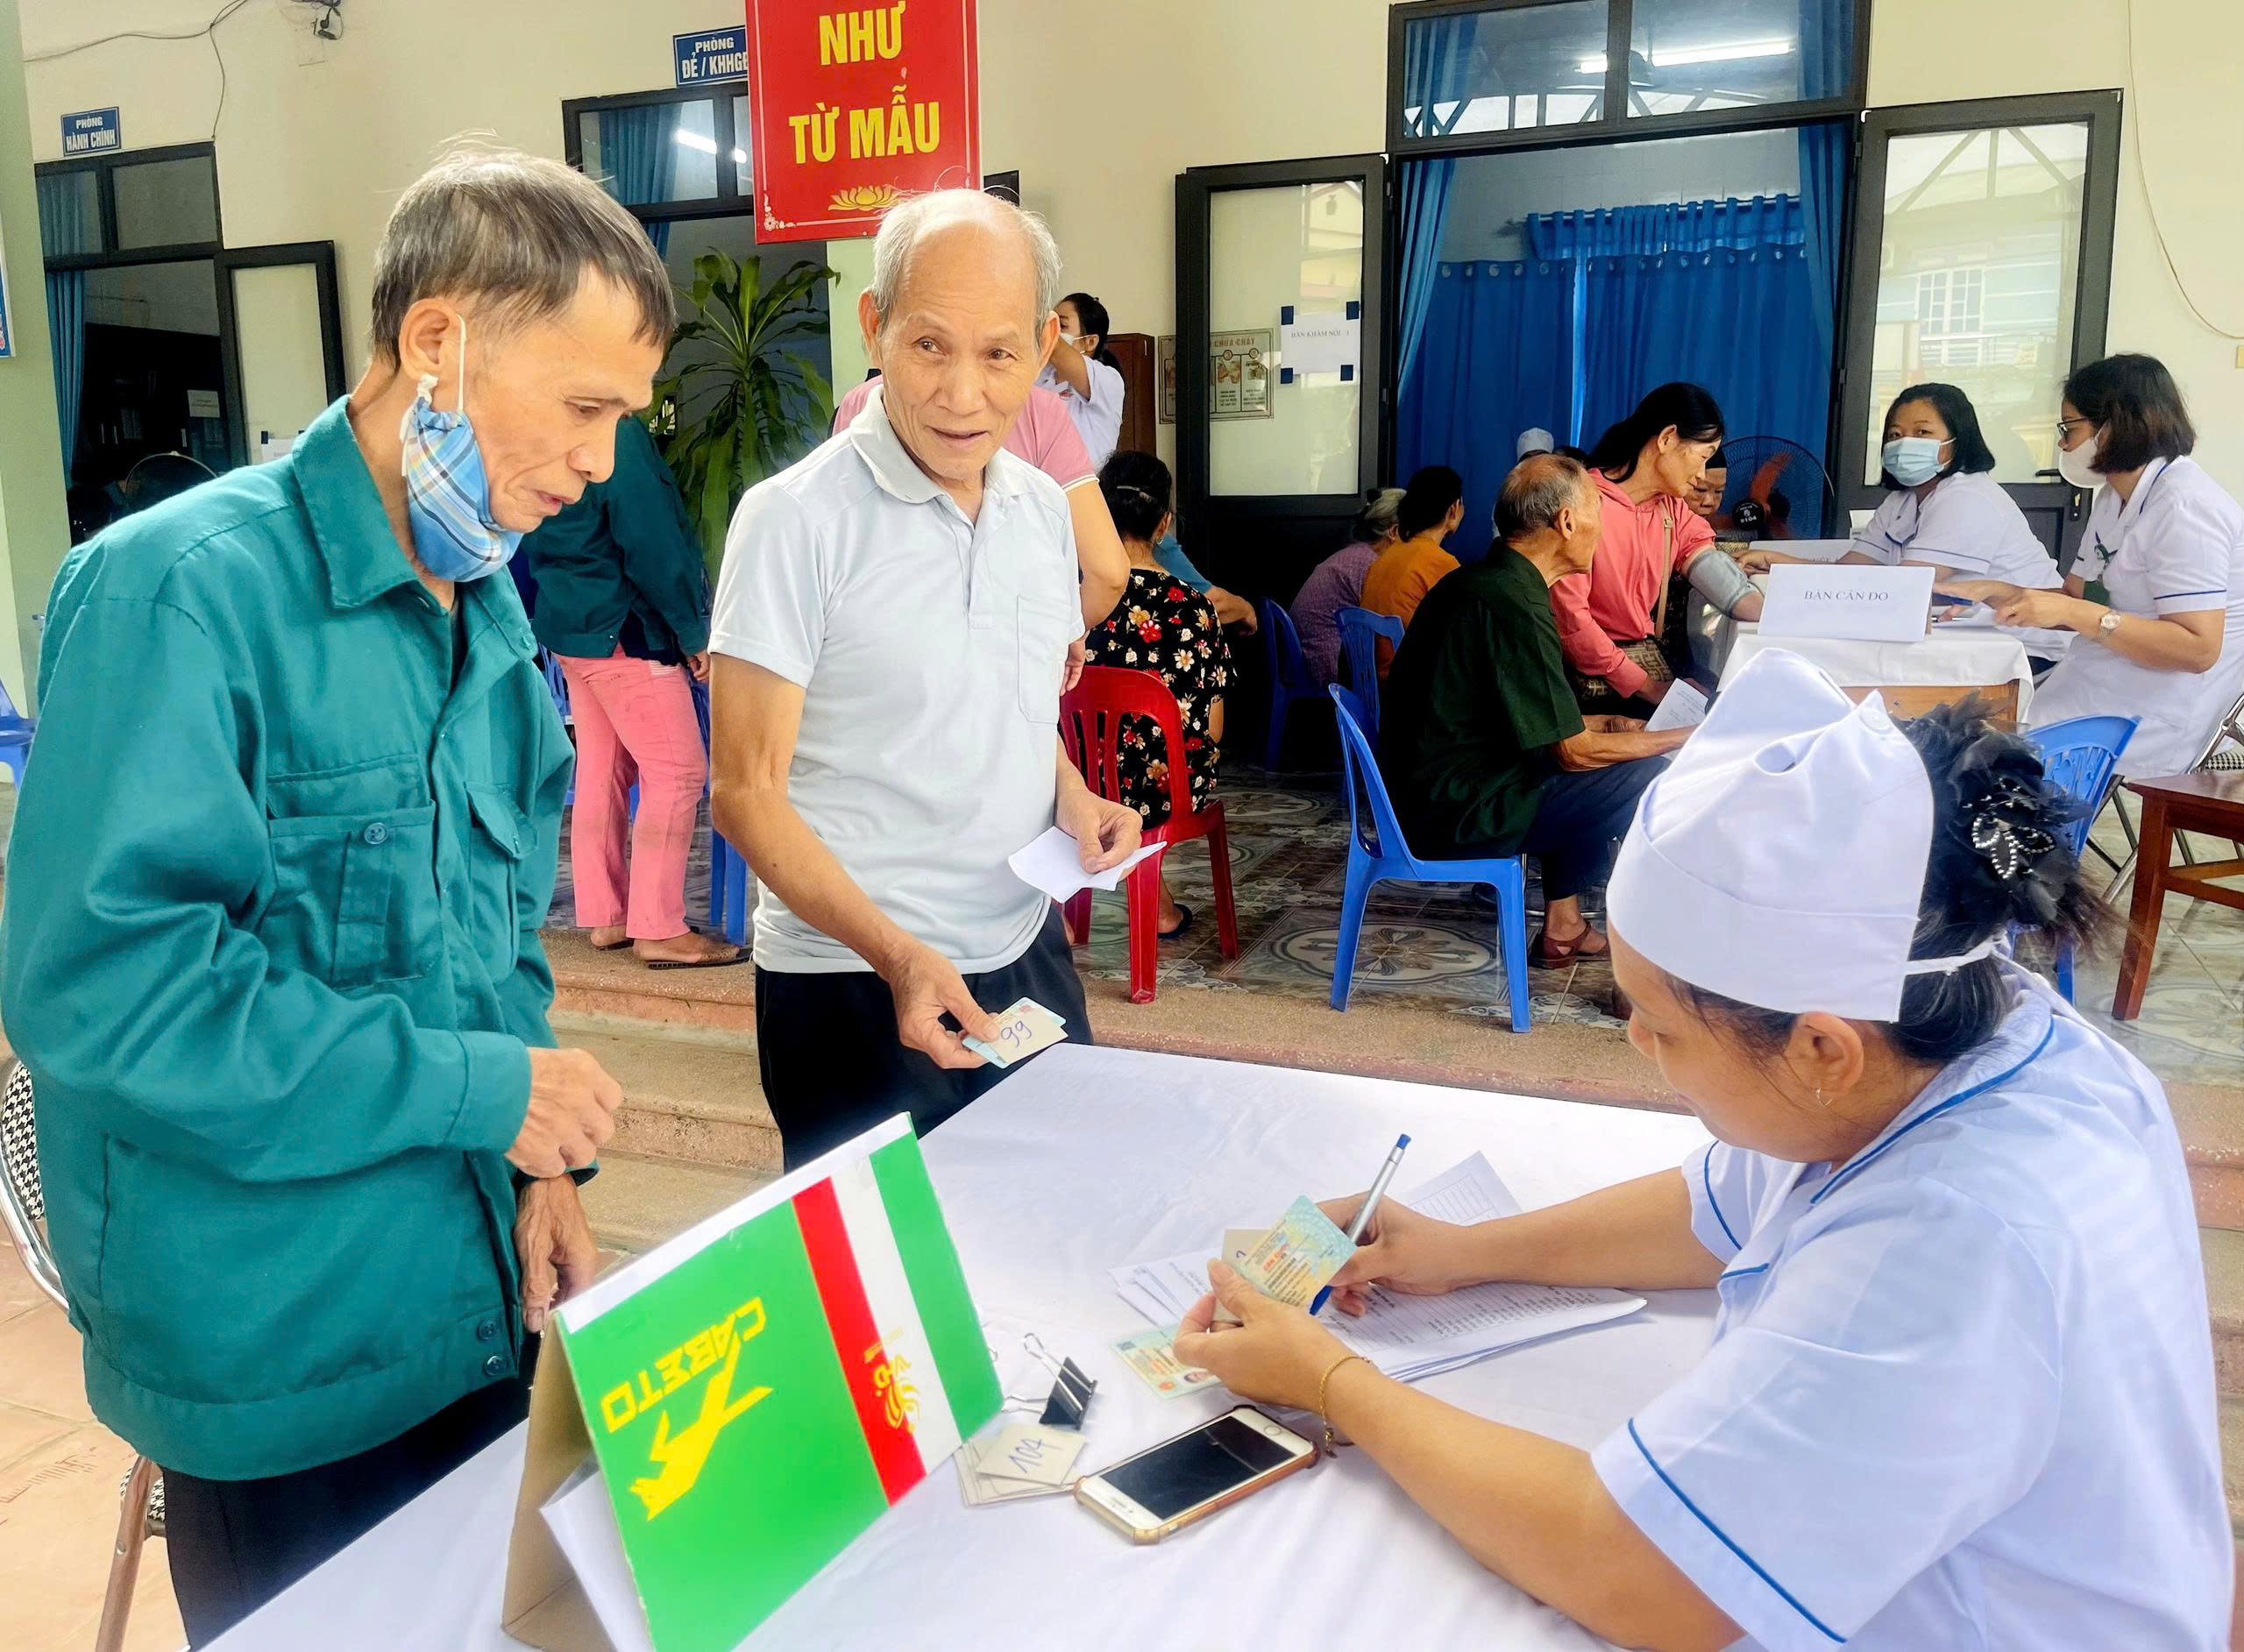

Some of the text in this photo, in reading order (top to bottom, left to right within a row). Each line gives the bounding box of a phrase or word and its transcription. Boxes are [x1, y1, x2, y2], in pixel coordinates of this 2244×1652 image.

[694, 37, 735, 53] PHÒNG
[819, 0, 906, 66] NHƯ
[75, 116, 103, 129] PHÒNG
[788, 84, 941, 164] TỪ MẪU
[66, 128, 116, 152] HÀNH CHÍNH
[1000, 1020, 1033, 1048] 99
[600, 1296, 766, 1434] CABETO
[1007, 1438, 1063, 1474] 104
